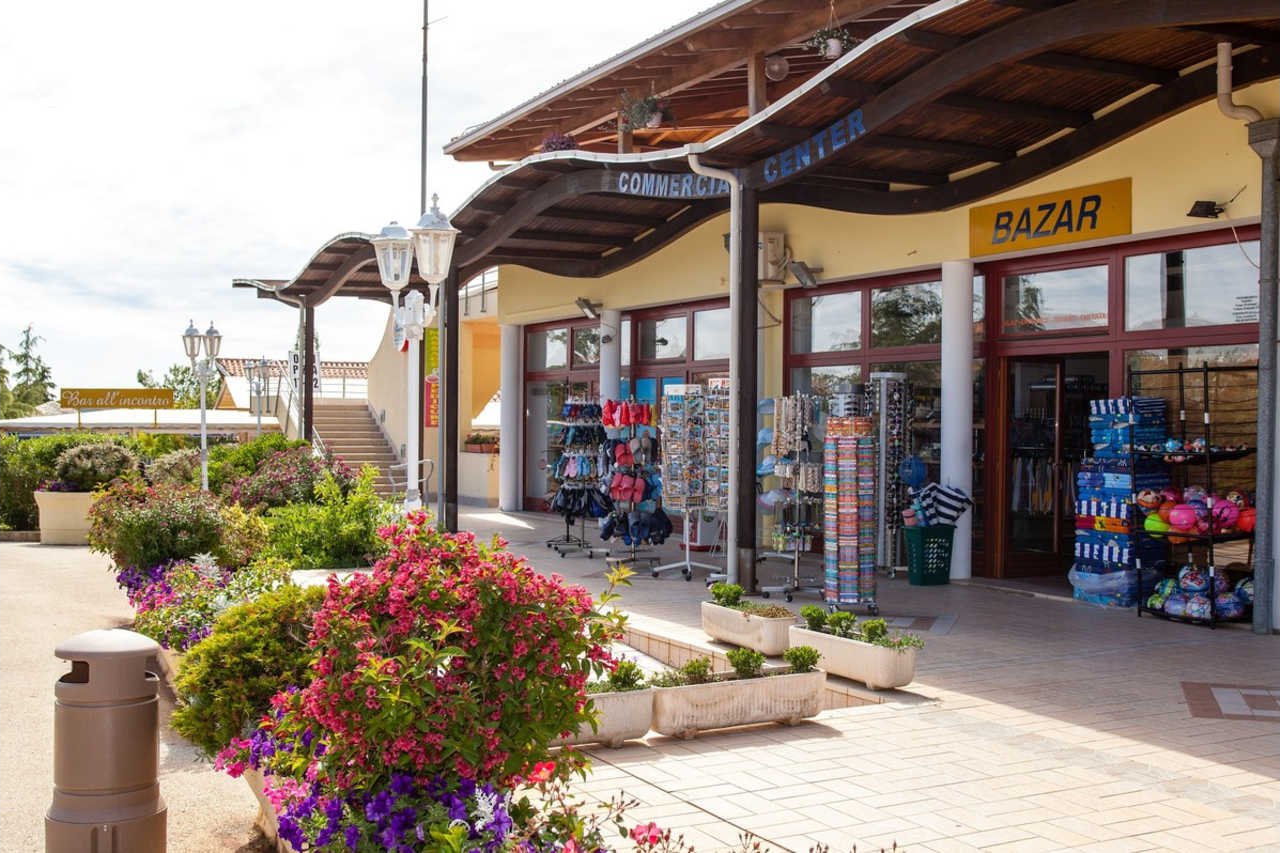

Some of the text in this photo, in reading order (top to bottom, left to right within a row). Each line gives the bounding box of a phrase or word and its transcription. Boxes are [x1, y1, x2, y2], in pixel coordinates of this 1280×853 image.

[618, 108, 866, 197] COMMERCIA CENTER
[991, 194, 1102, 245] BAZAR
[62, 390, 92, 406] Bar
